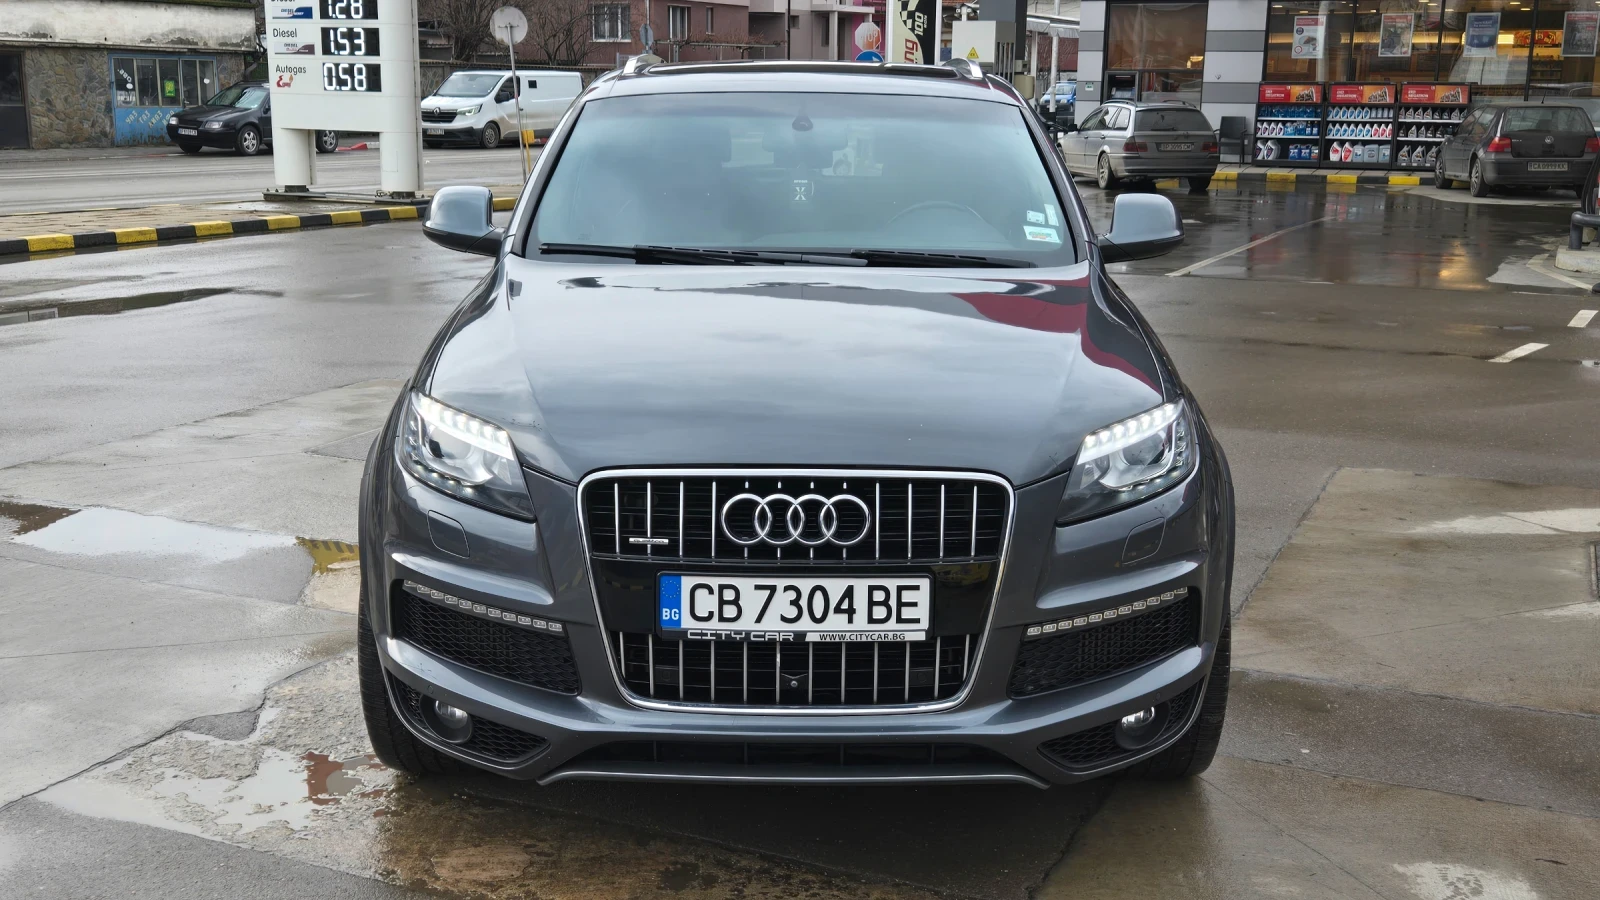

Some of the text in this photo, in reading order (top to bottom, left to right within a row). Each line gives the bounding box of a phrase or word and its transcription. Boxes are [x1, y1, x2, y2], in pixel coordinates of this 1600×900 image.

[328, 0, 363, 19] 1.28
[914, 11, 924, 36] 100
[272, 28, 298, 38] Diesel
[329, 27, 365, 56] 1.53
[275, 64, 307, 76] Autogas
[323, 62, 367, 91] 0.58
[689, 582, 921, 625] CB 7304 BE
[662, 608, 680, 620] BG
[687, 629, 794, 642] CITY CAR
[818, 632, 906, 642] WWW.CITYCAR.BG
